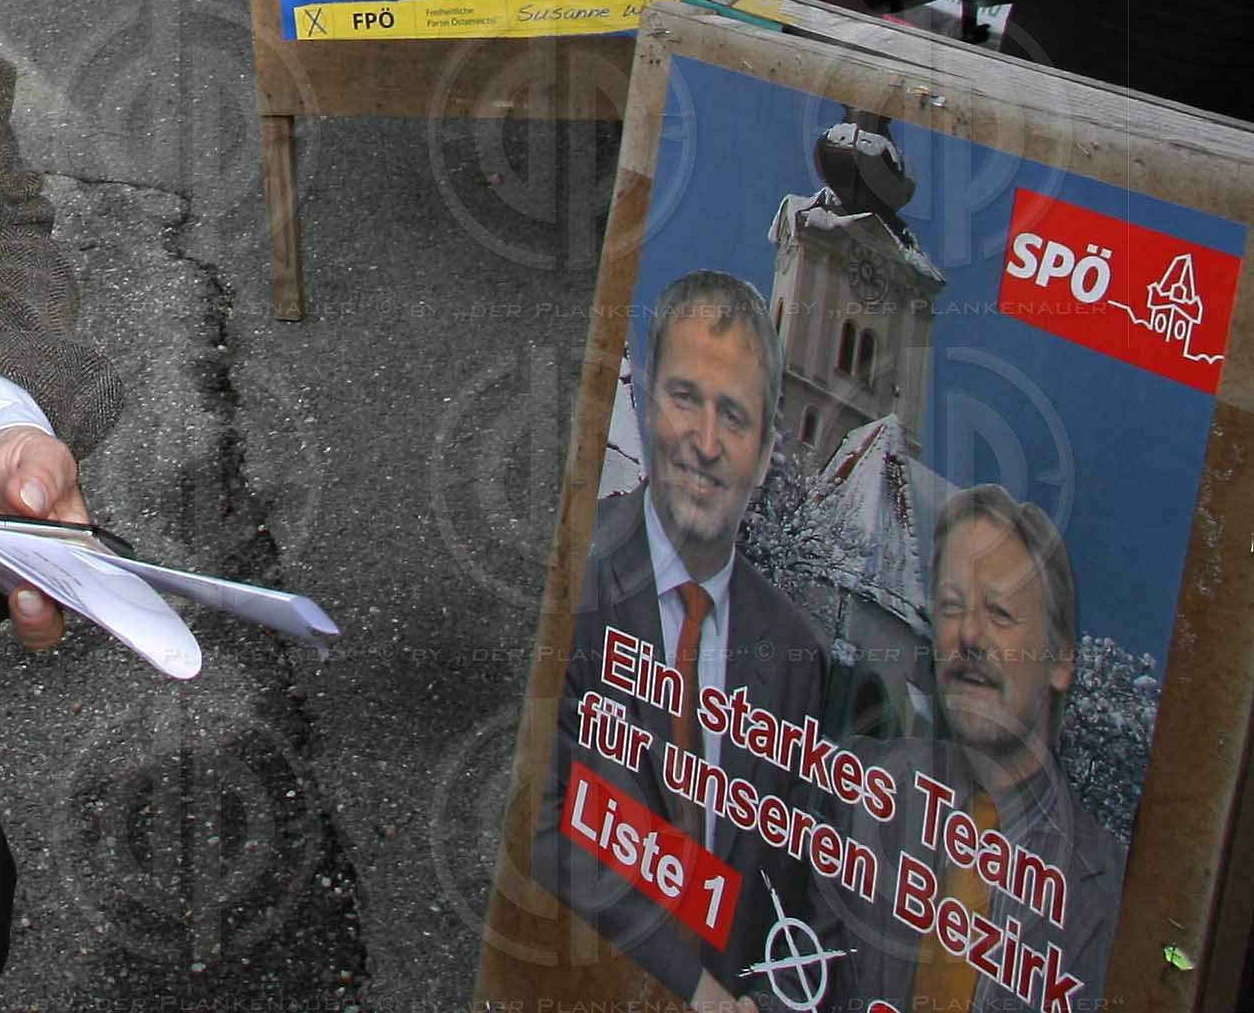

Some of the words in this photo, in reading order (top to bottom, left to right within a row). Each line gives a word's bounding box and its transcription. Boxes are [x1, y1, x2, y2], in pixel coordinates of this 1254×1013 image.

[353, 8, 395, 30] FPÖ
[519, 4, 611, 22] Susanne
[1006, 232, 1112, 305] SPÖ
[600, 625, 684, 717] Ein
[697, 685, 897, 823] starkes
[914, 772, 1067, 928] Team
[571, 780, 686, 898] Liste
[703, 874, 728, 931] 1
[577, 691, 650, 773] für
[662, 743, 878, 904] unseren
[893, 851, 1085, 1013] Bezirk
